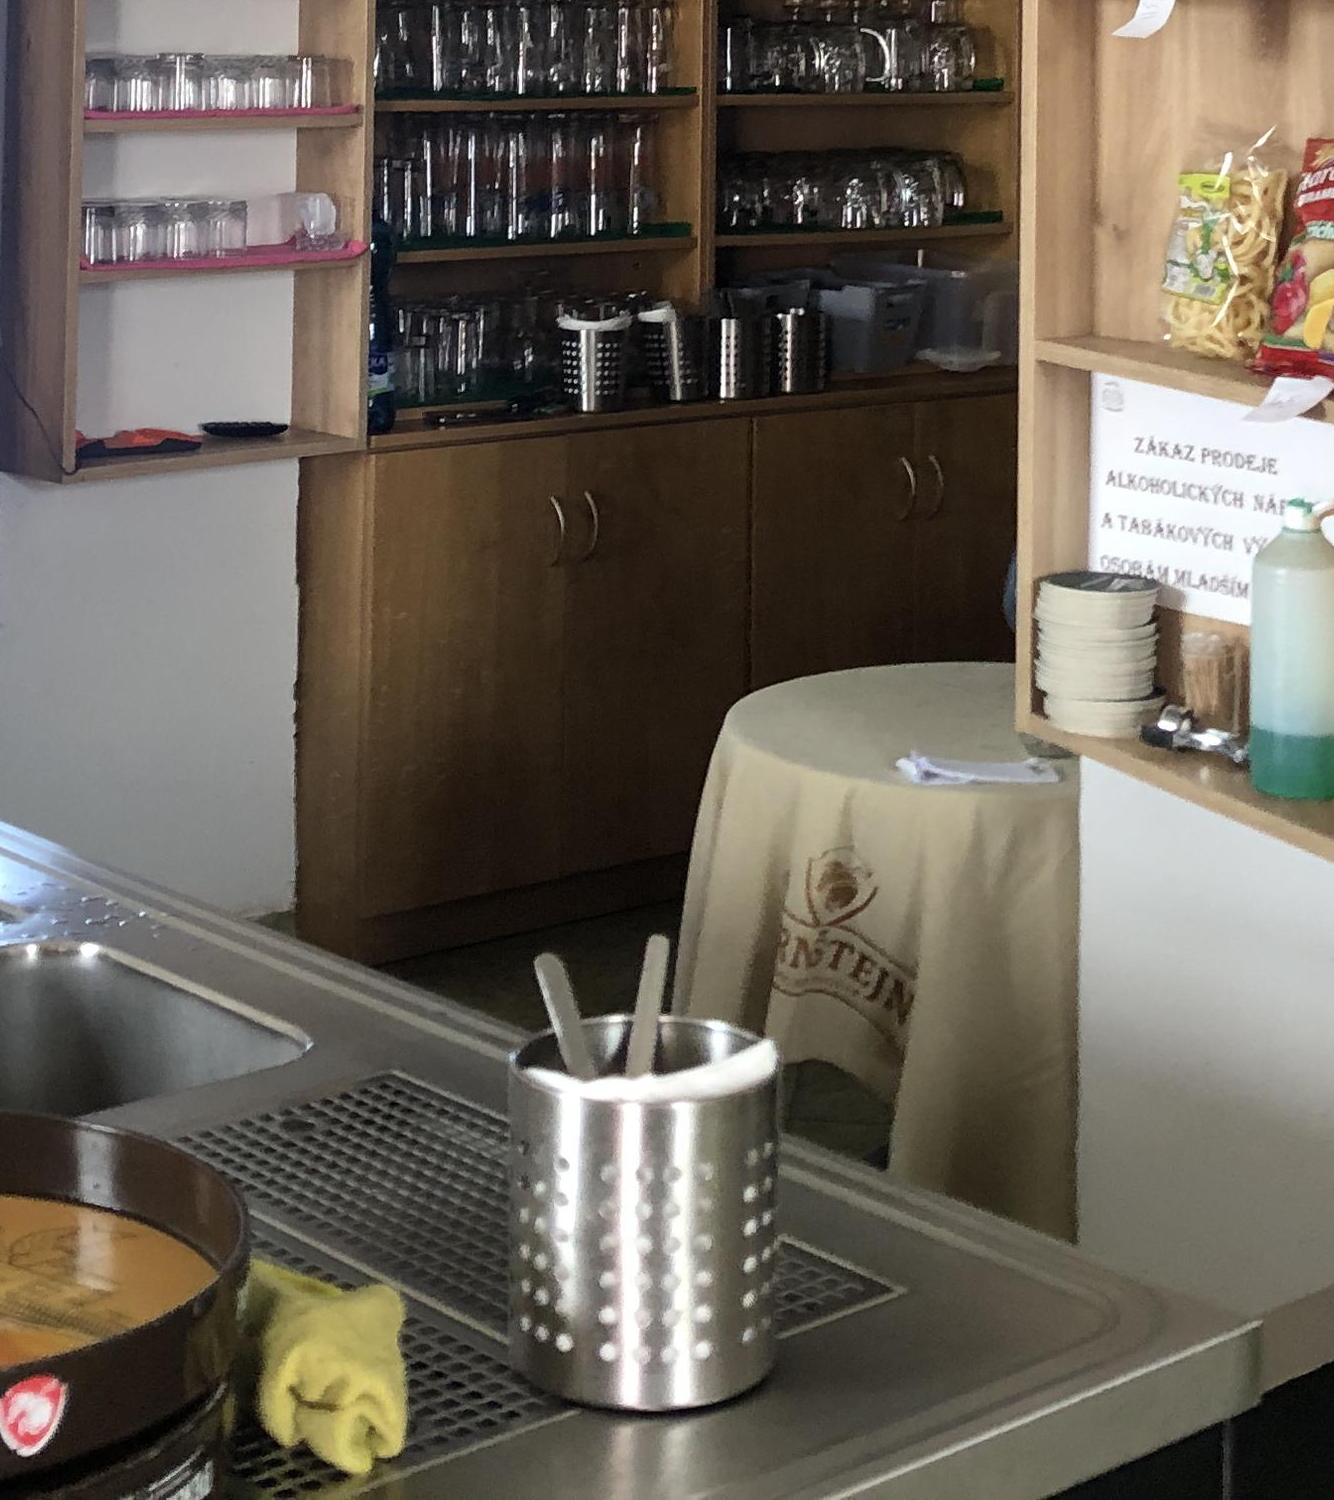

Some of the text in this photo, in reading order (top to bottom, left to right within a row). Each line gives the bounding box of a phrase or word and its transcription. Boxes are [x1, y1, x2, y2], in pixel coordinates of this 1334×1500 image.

[1133, 436, 1278, 475] ZÁKAZ PRODEJE
[1106, 470, 1245, 509] ALKOHOLICKÝCH
[1100, 512, 1113, 530] A
